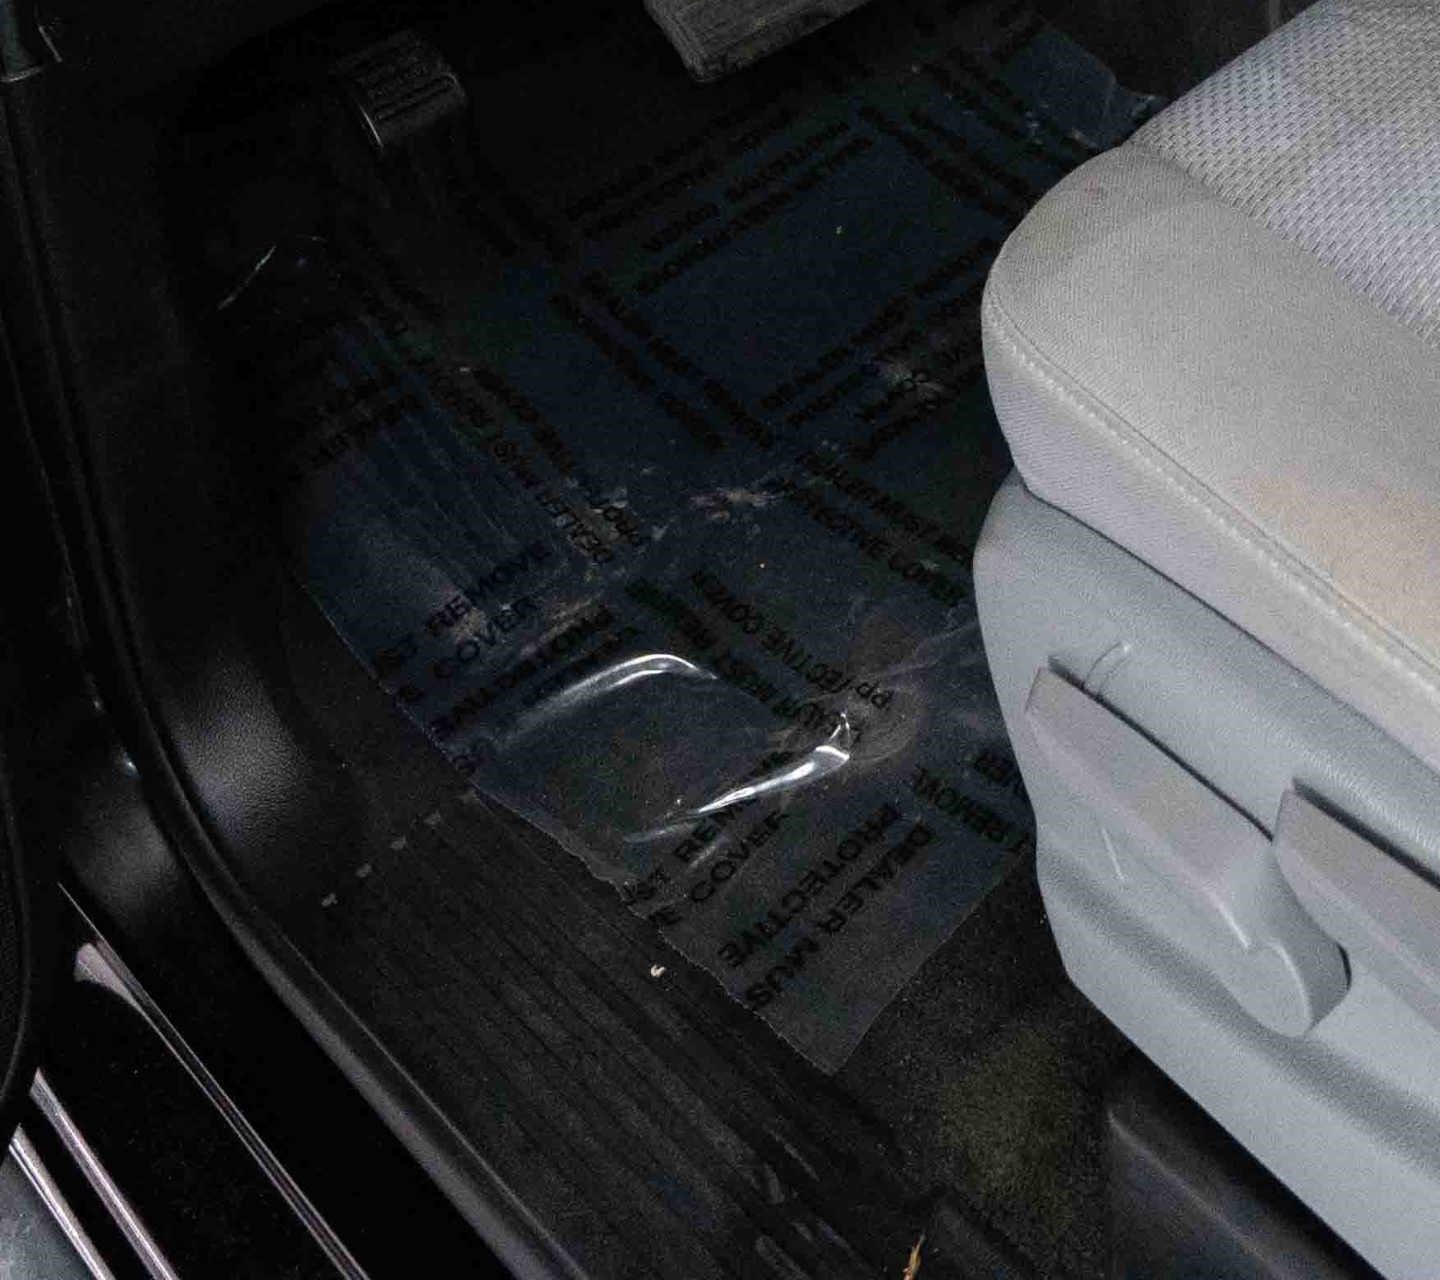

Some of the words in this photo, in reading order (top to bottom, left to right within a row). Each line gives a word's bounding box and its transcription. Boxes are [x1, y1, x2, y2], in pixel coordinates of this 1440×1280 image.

[534, 485, 616, 569] DEALER
[421, 534, 552, 642] REMOVE
[686, 561, 764, 638] COVER
[428, 592, 540, 684] COVER
[761, 625, 893, 709] PRTECTIVE
[686, 806, 792, 906] COVER
[716, 801, 902, 969] PROTECTIVE
[816, 823, 934, 935] DEALER
